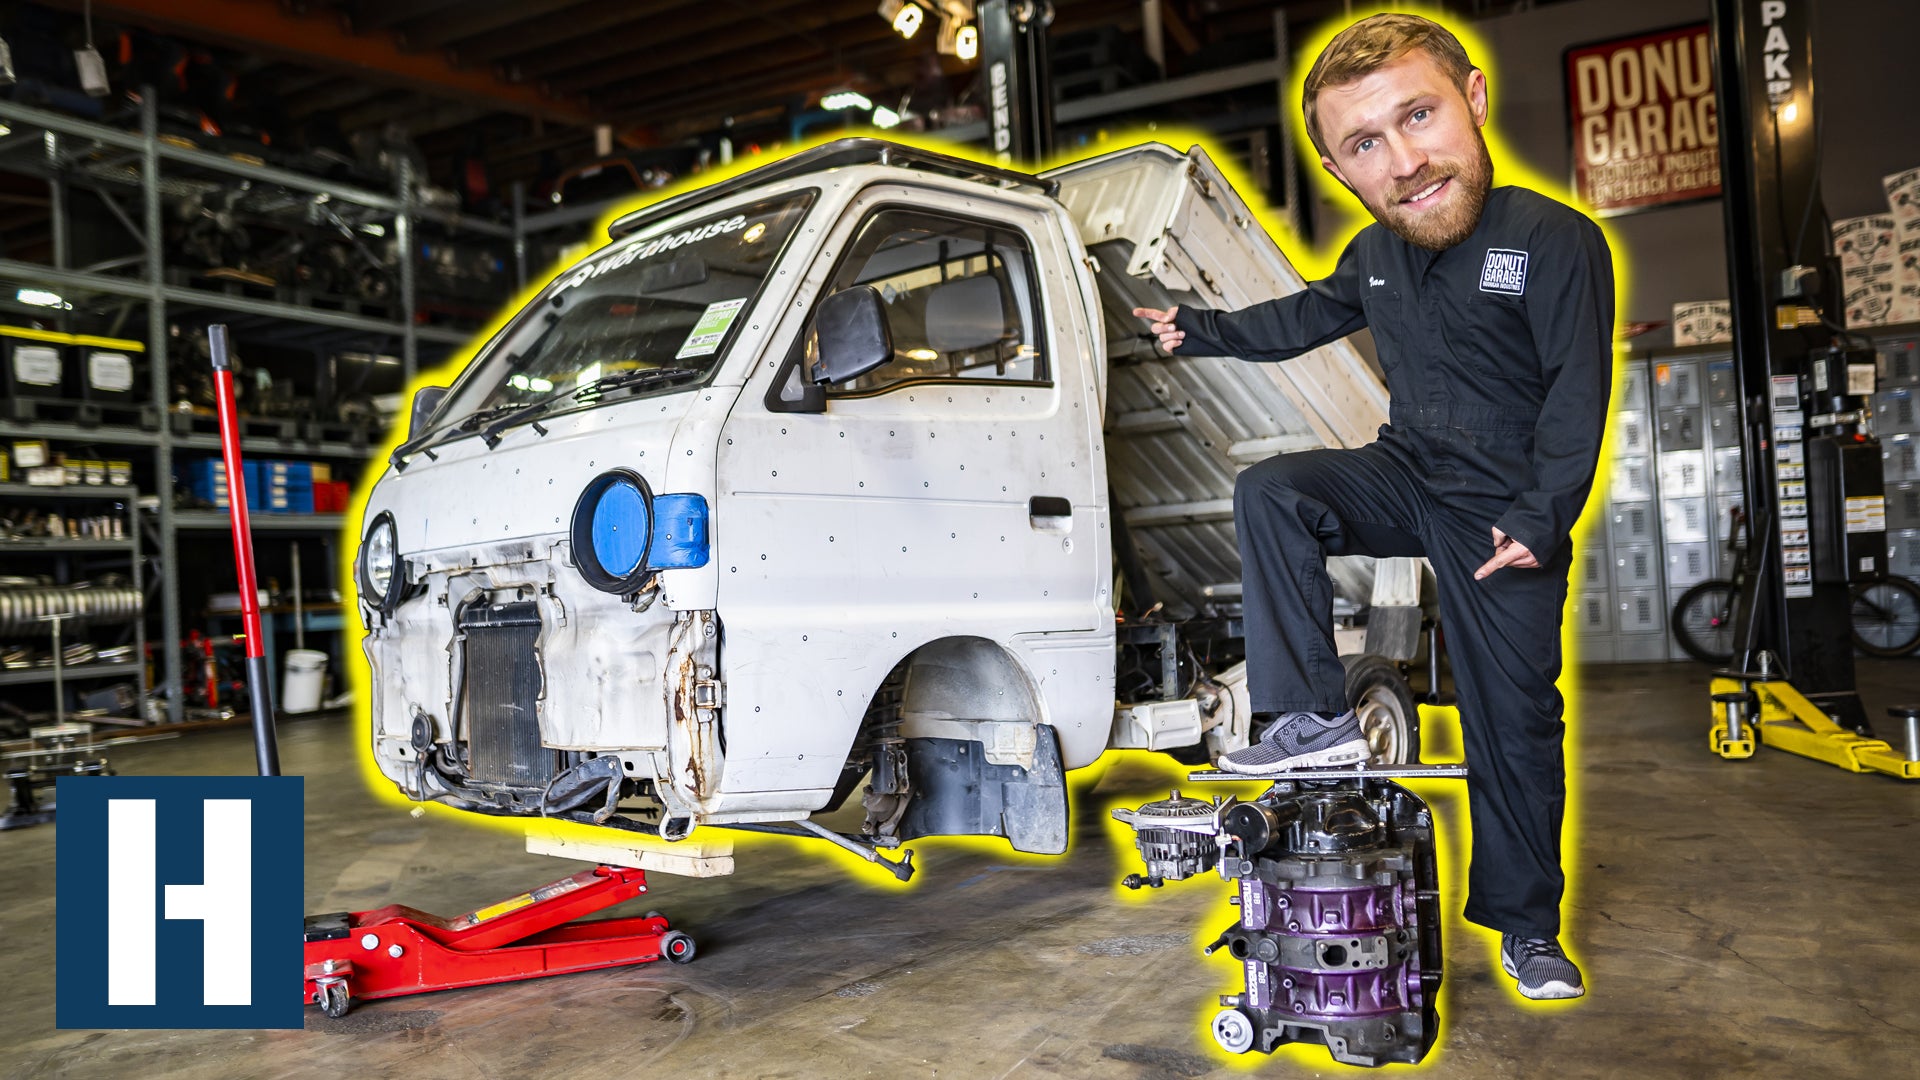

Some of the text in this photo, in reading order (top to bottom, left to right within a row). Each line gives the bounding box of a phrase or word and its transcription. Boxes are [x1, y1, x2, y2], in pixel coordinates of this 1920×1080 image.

[1760, 0, 1791, 80] PAK
[1577, 33, 1712, 116] DONU
[1582, 95, 1718, 166] GARAG
[1587, 149, 1719, 185] HOONIGAN INDUST
[1672, 168, 1721, 192] CALIFO
[1484, 268, 1523, 285] GARAGE
[1486, 253, 1525, 272] DONUT
